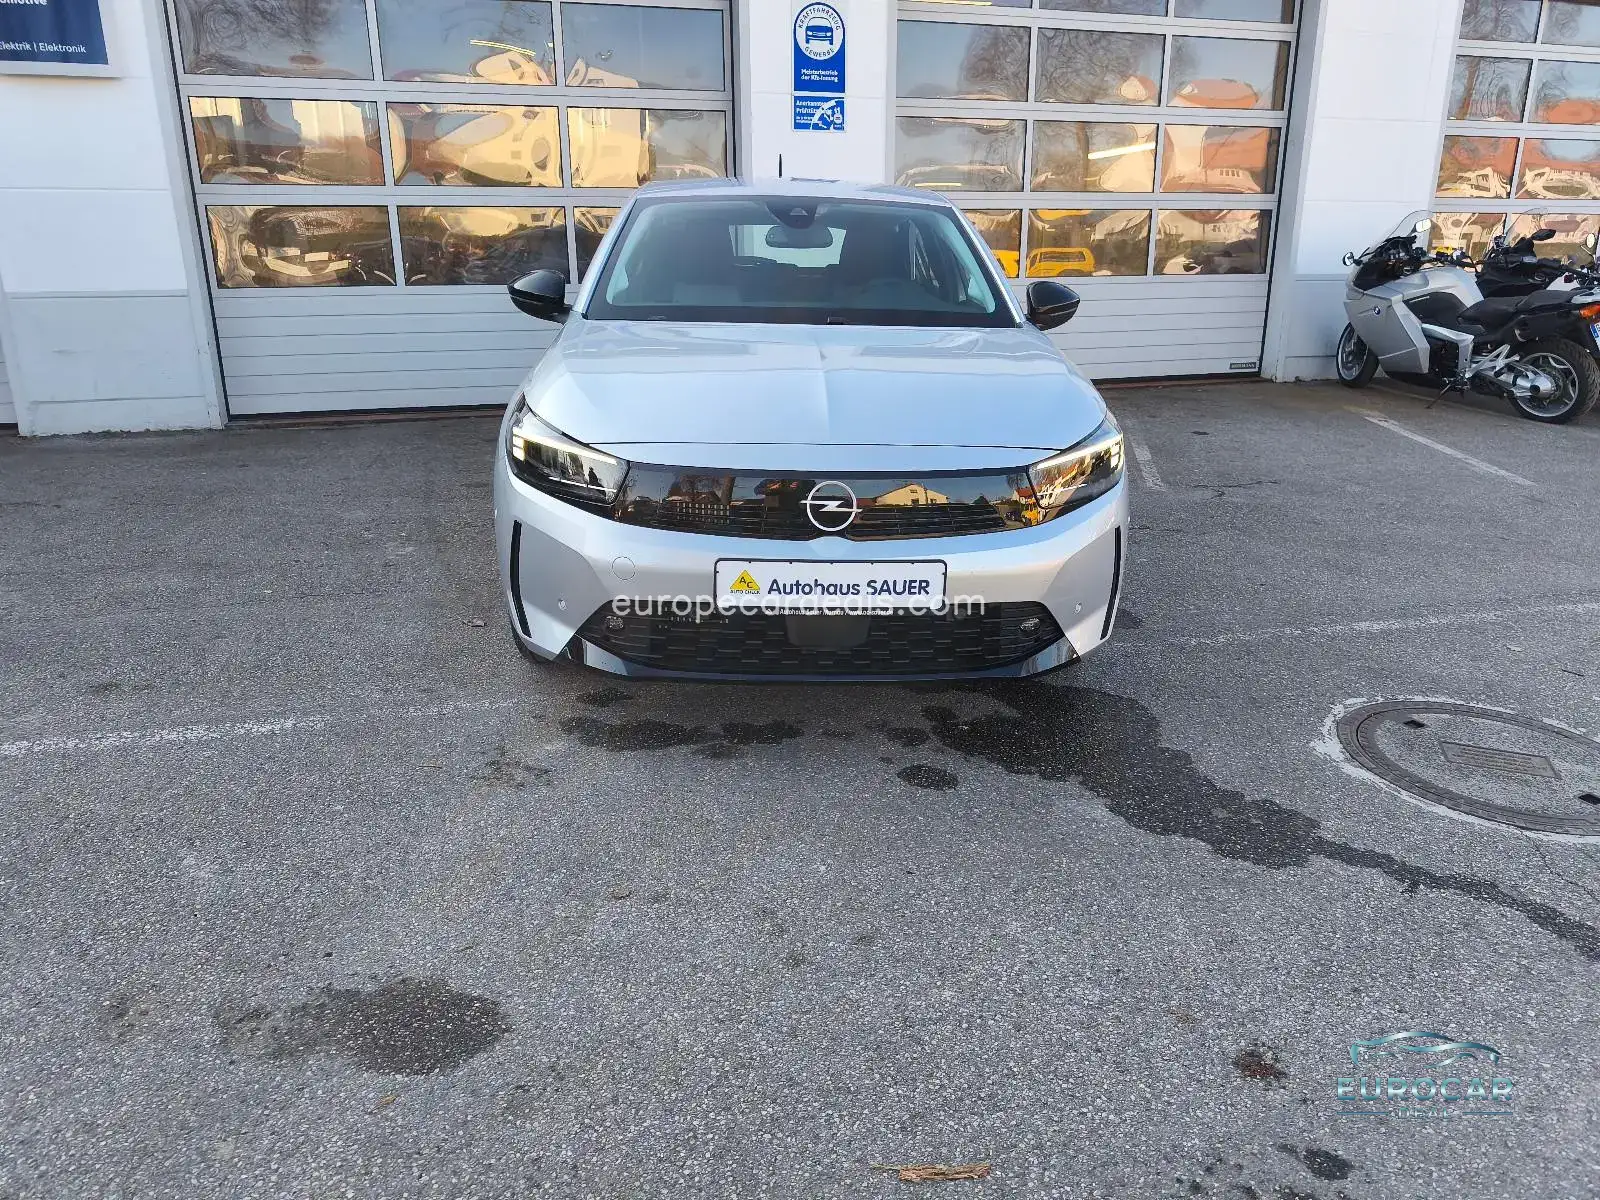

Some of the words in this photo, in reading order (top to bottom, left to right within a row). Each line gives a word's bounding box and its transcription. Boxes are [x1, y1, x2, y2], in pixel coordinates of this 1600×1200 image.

[798, 8, 841, 30] KRAFTFAHRZEUG
[39, 42, 87, 53] Elektronik
[805, 46, 835, 57] GEWERBE
[767, 579, 860, 595] Autohaus
[866, 579, 930, 595] SAUER
